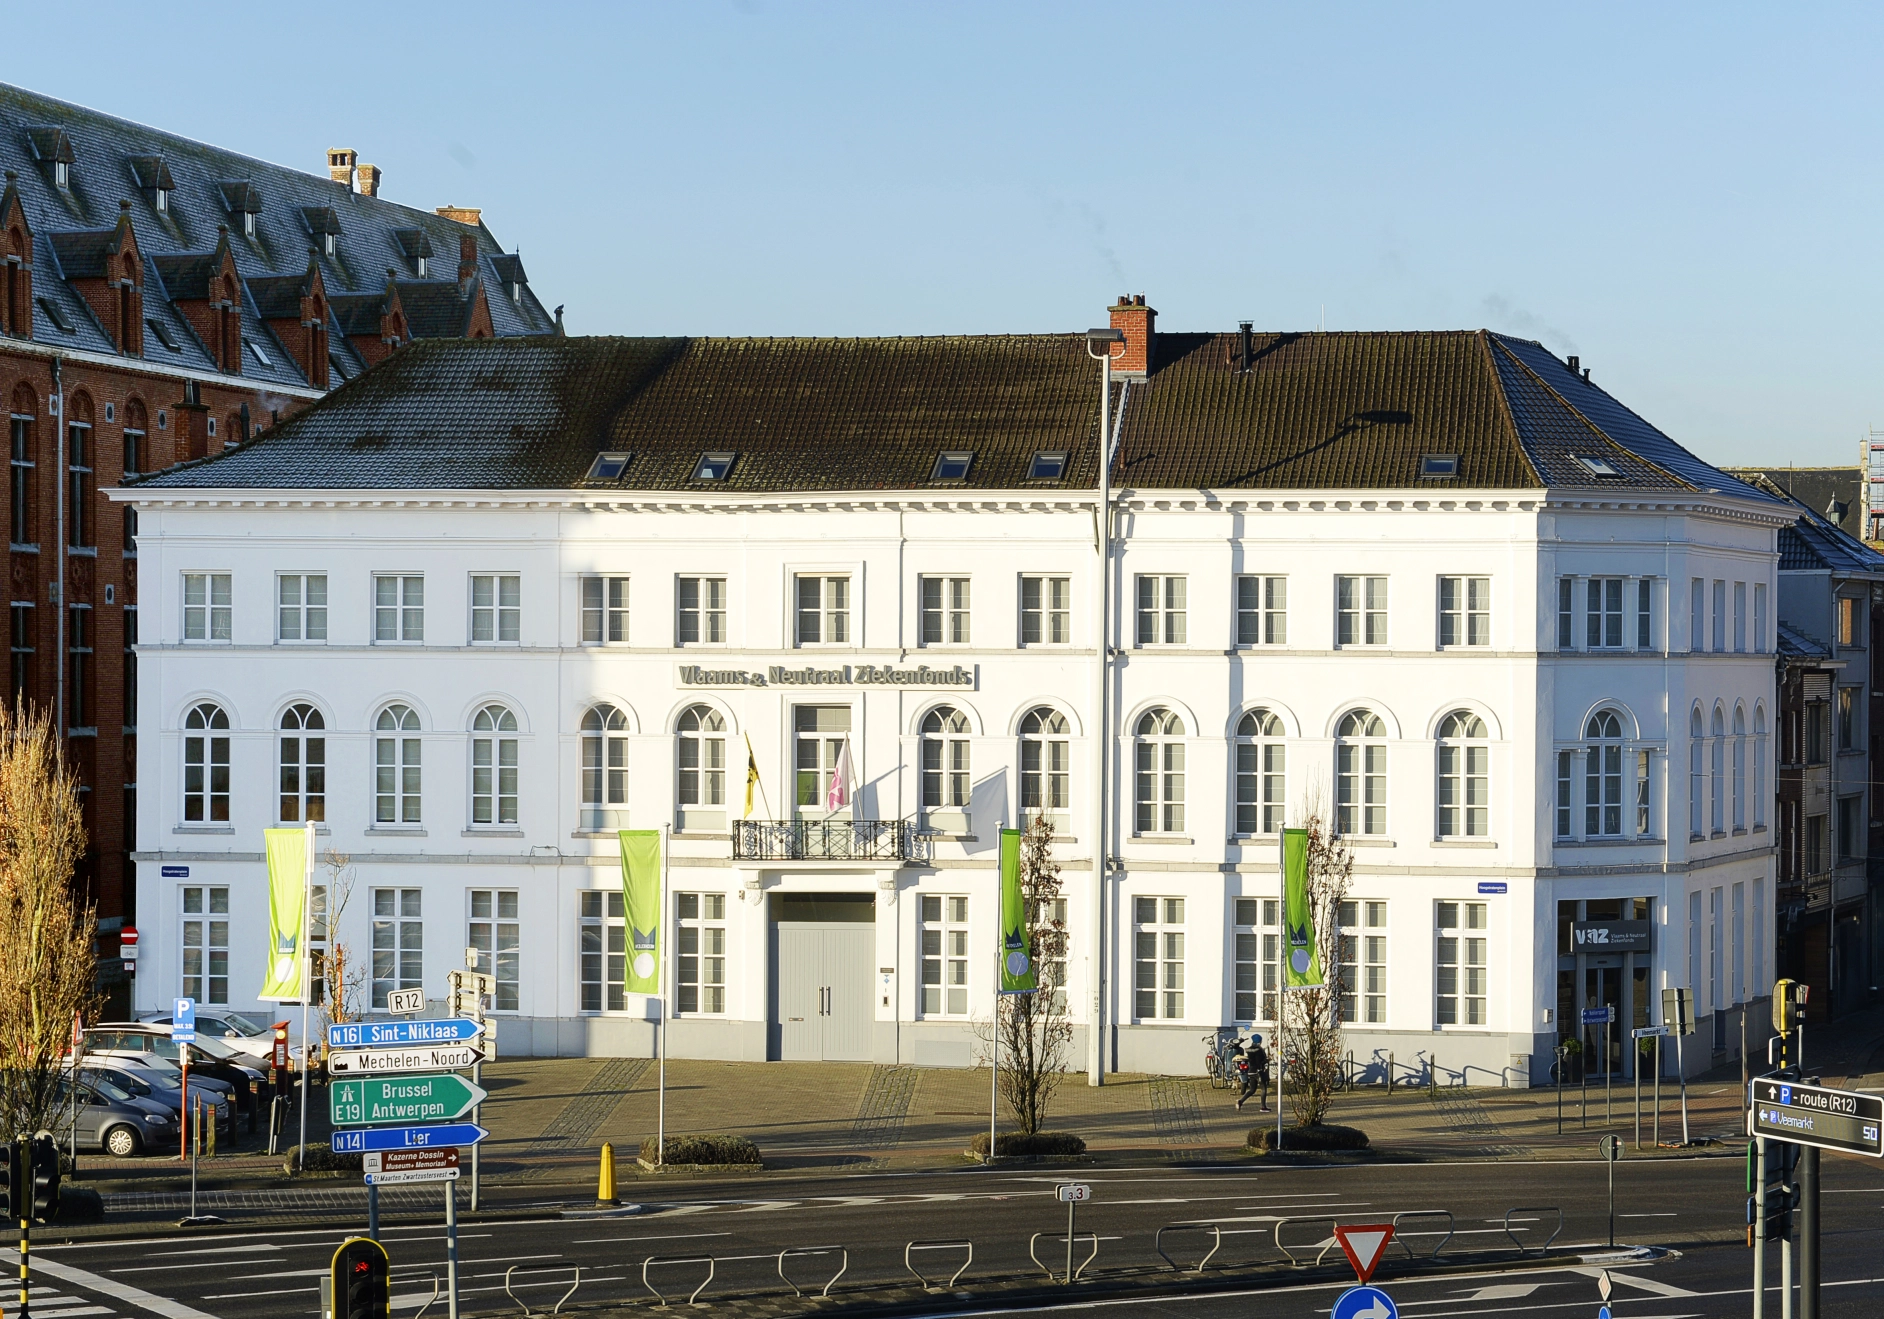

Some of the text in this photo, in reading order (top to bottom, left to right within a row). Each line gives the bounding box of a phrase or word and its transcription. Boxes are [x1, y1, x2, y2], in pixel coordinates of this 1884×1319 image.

[679, 664, 969, 687] Vlaams & Neutraal Ziekenfonds
[177, 1000, 190, 1019] P
[371, 1023, 459, 1041] Sint-Niklaas
[382, 1081, 432, 1099] Brussel
[371, 1102, 445, 1119] Antwerpen
[1800, 1094, 1828, 1108] route
[1829, 1094, 1857, 1114] (R12)
[1777, 1112, 1814, 1130] Veemarkt
[404, 1130, 431, 1146] Lier
[387, 1150, 444, 1162] Kazerne Dossin
[415, 1159, 447, 1168] Memoriaal
